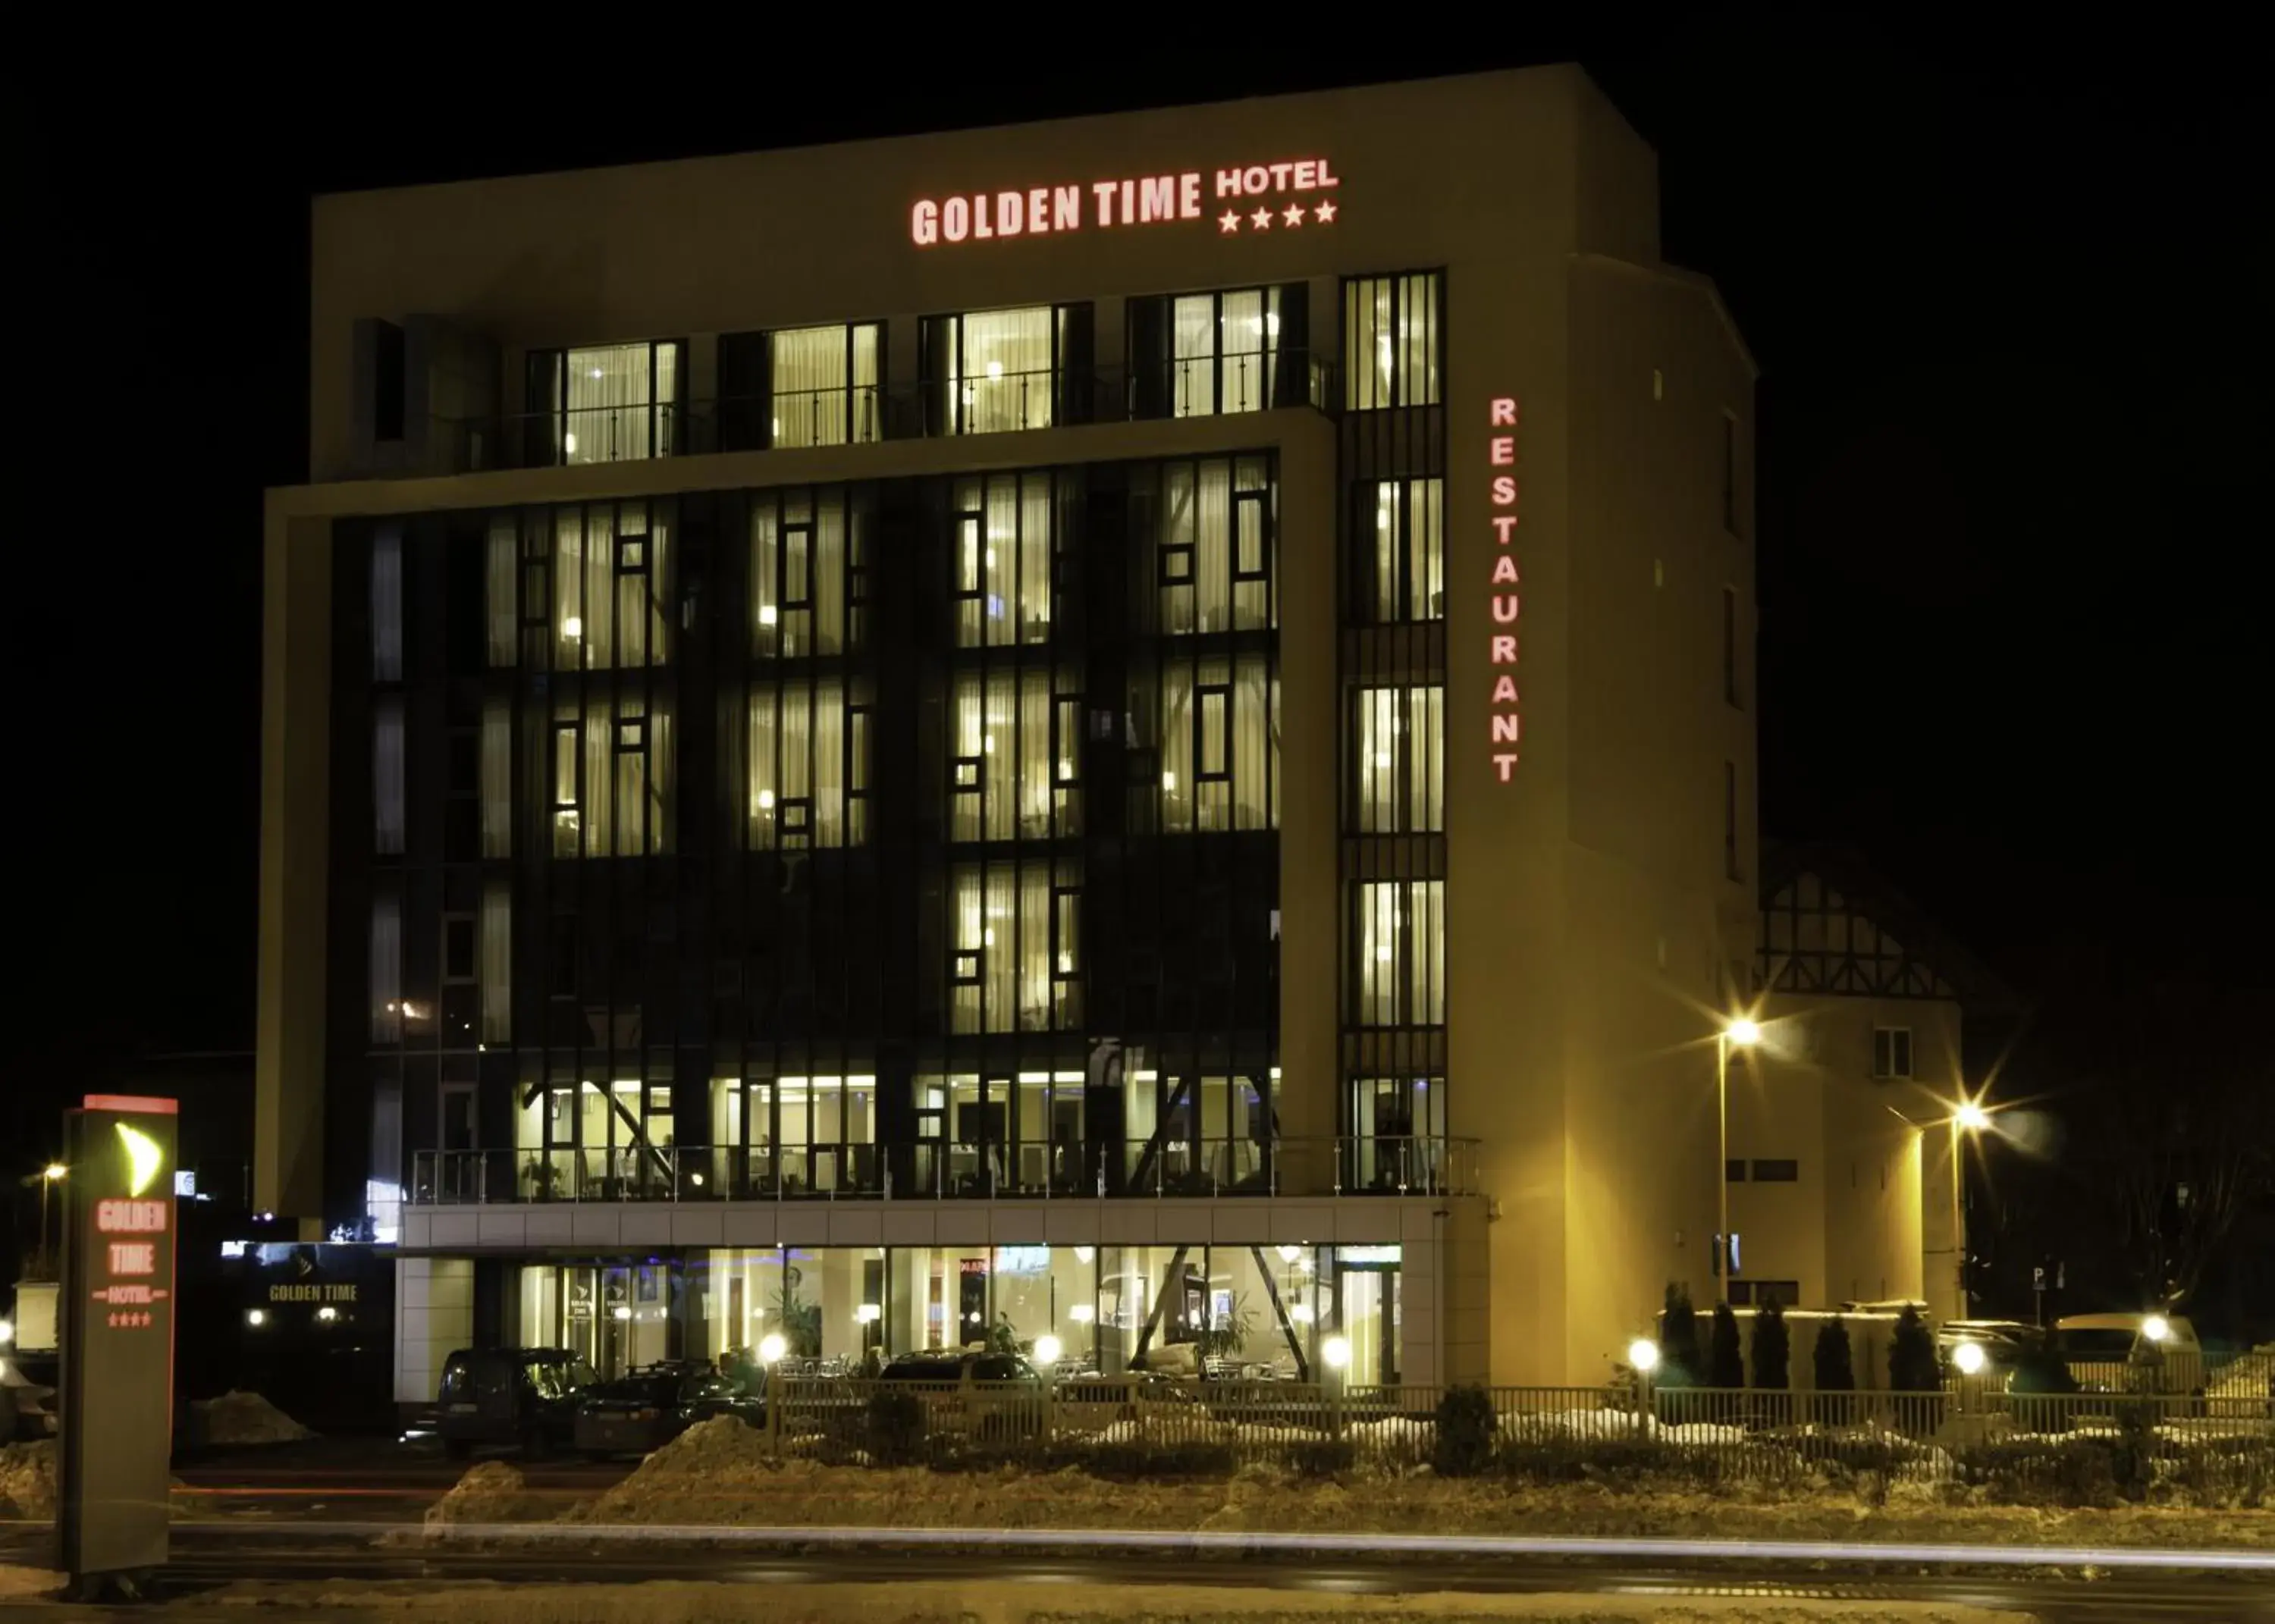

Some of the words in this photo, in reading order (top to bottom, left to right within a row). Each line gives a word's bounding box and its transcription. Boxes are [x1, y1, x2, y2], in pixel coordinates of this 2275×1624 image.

[912, 187, 1079, 246] GOLDEN
[1093, 173, 1201, 226] TIME
[1216, 159, 1339, 197] HOTEL
[1490, 397, 1519, 782] RESTAURANT
[97, 1199, 166, 1233] GOLDEN
[108, 1243, 155, 1274] TIME
[2034, 1267, 2044, 1282] P
[108, 1285, 152, 1304] HOTEL
[269, 1284, 321, 1302] GOLDEN
[325, 1284, 357, 1301] TIME
